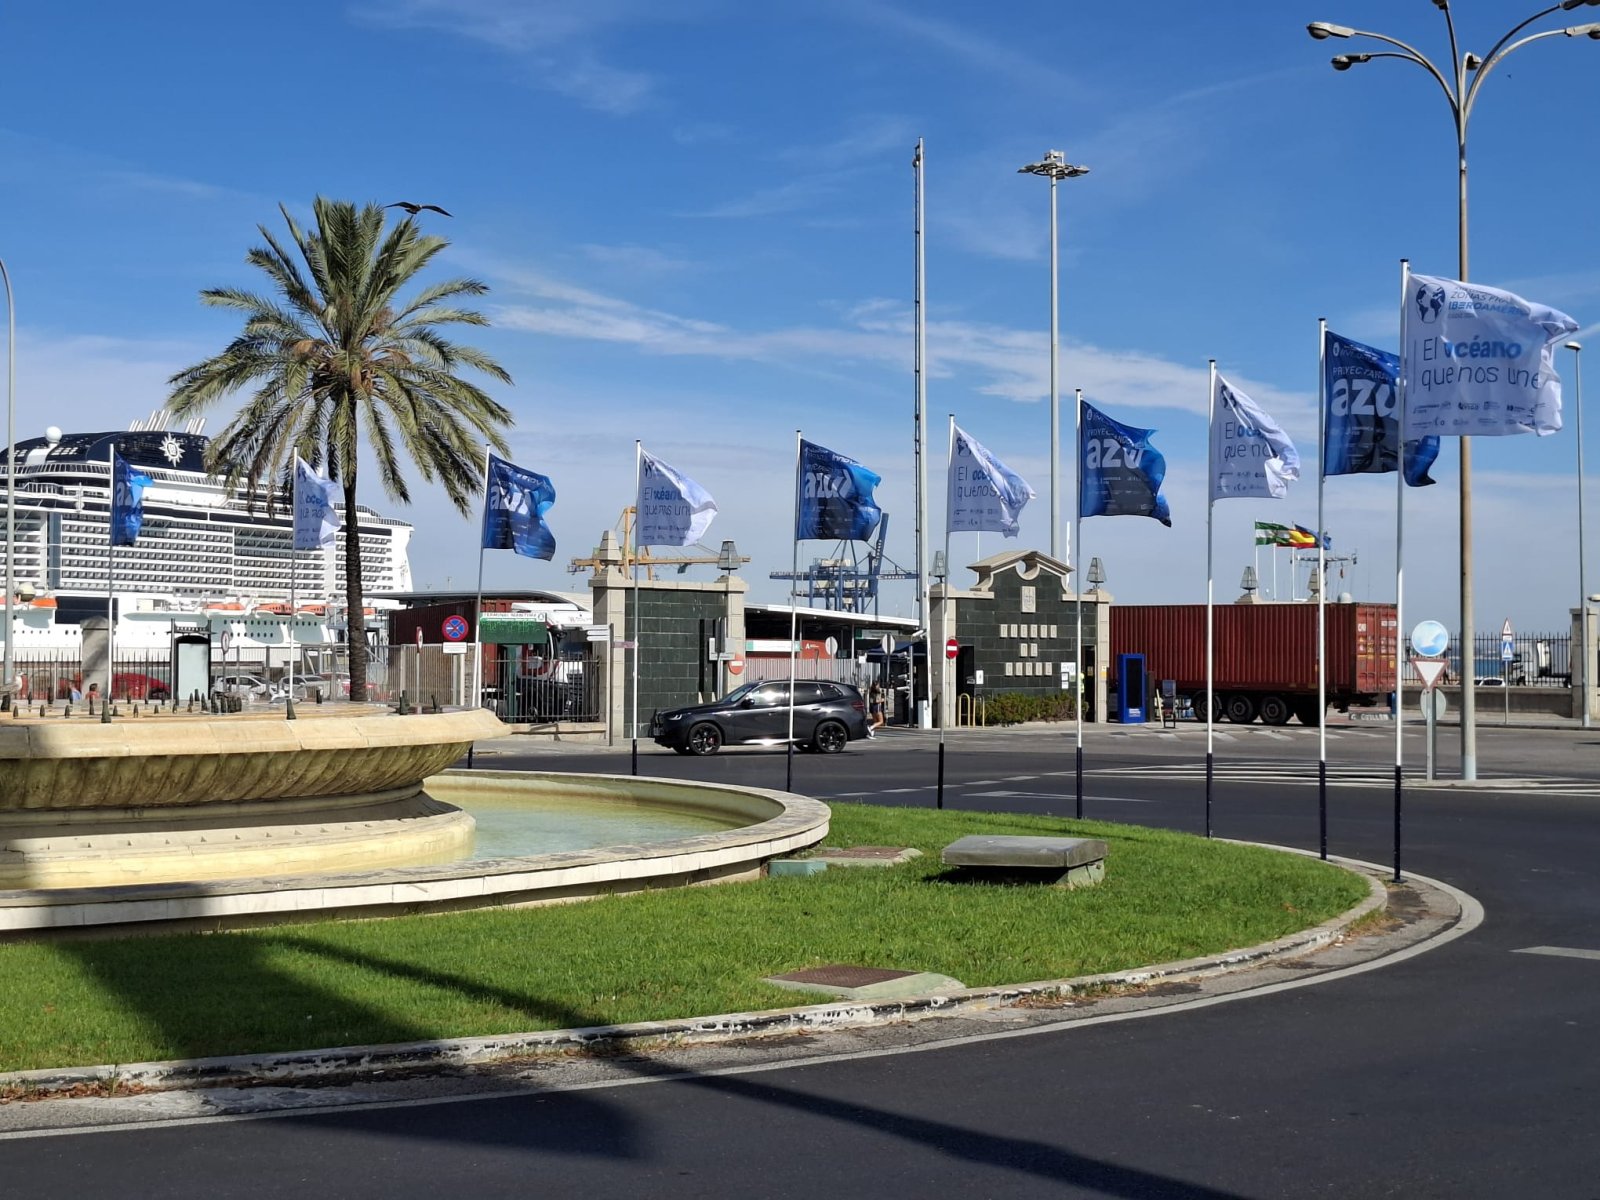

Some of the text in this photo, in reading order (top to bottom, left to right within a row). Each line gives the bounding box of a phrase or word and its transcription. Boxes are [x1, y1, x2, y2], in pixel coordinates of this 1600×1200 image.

[1450, 291, 1486, 300] ZONAS
[1423, 335, 1522, 361] El océano
[1422, 366, 1539, 392] que nos une
[1225, 421, 1236, 439] El
[1224, 444, 1246, 462] que
[958, 466, 968, 481] El
[957, 485, 998, 501] que nos
